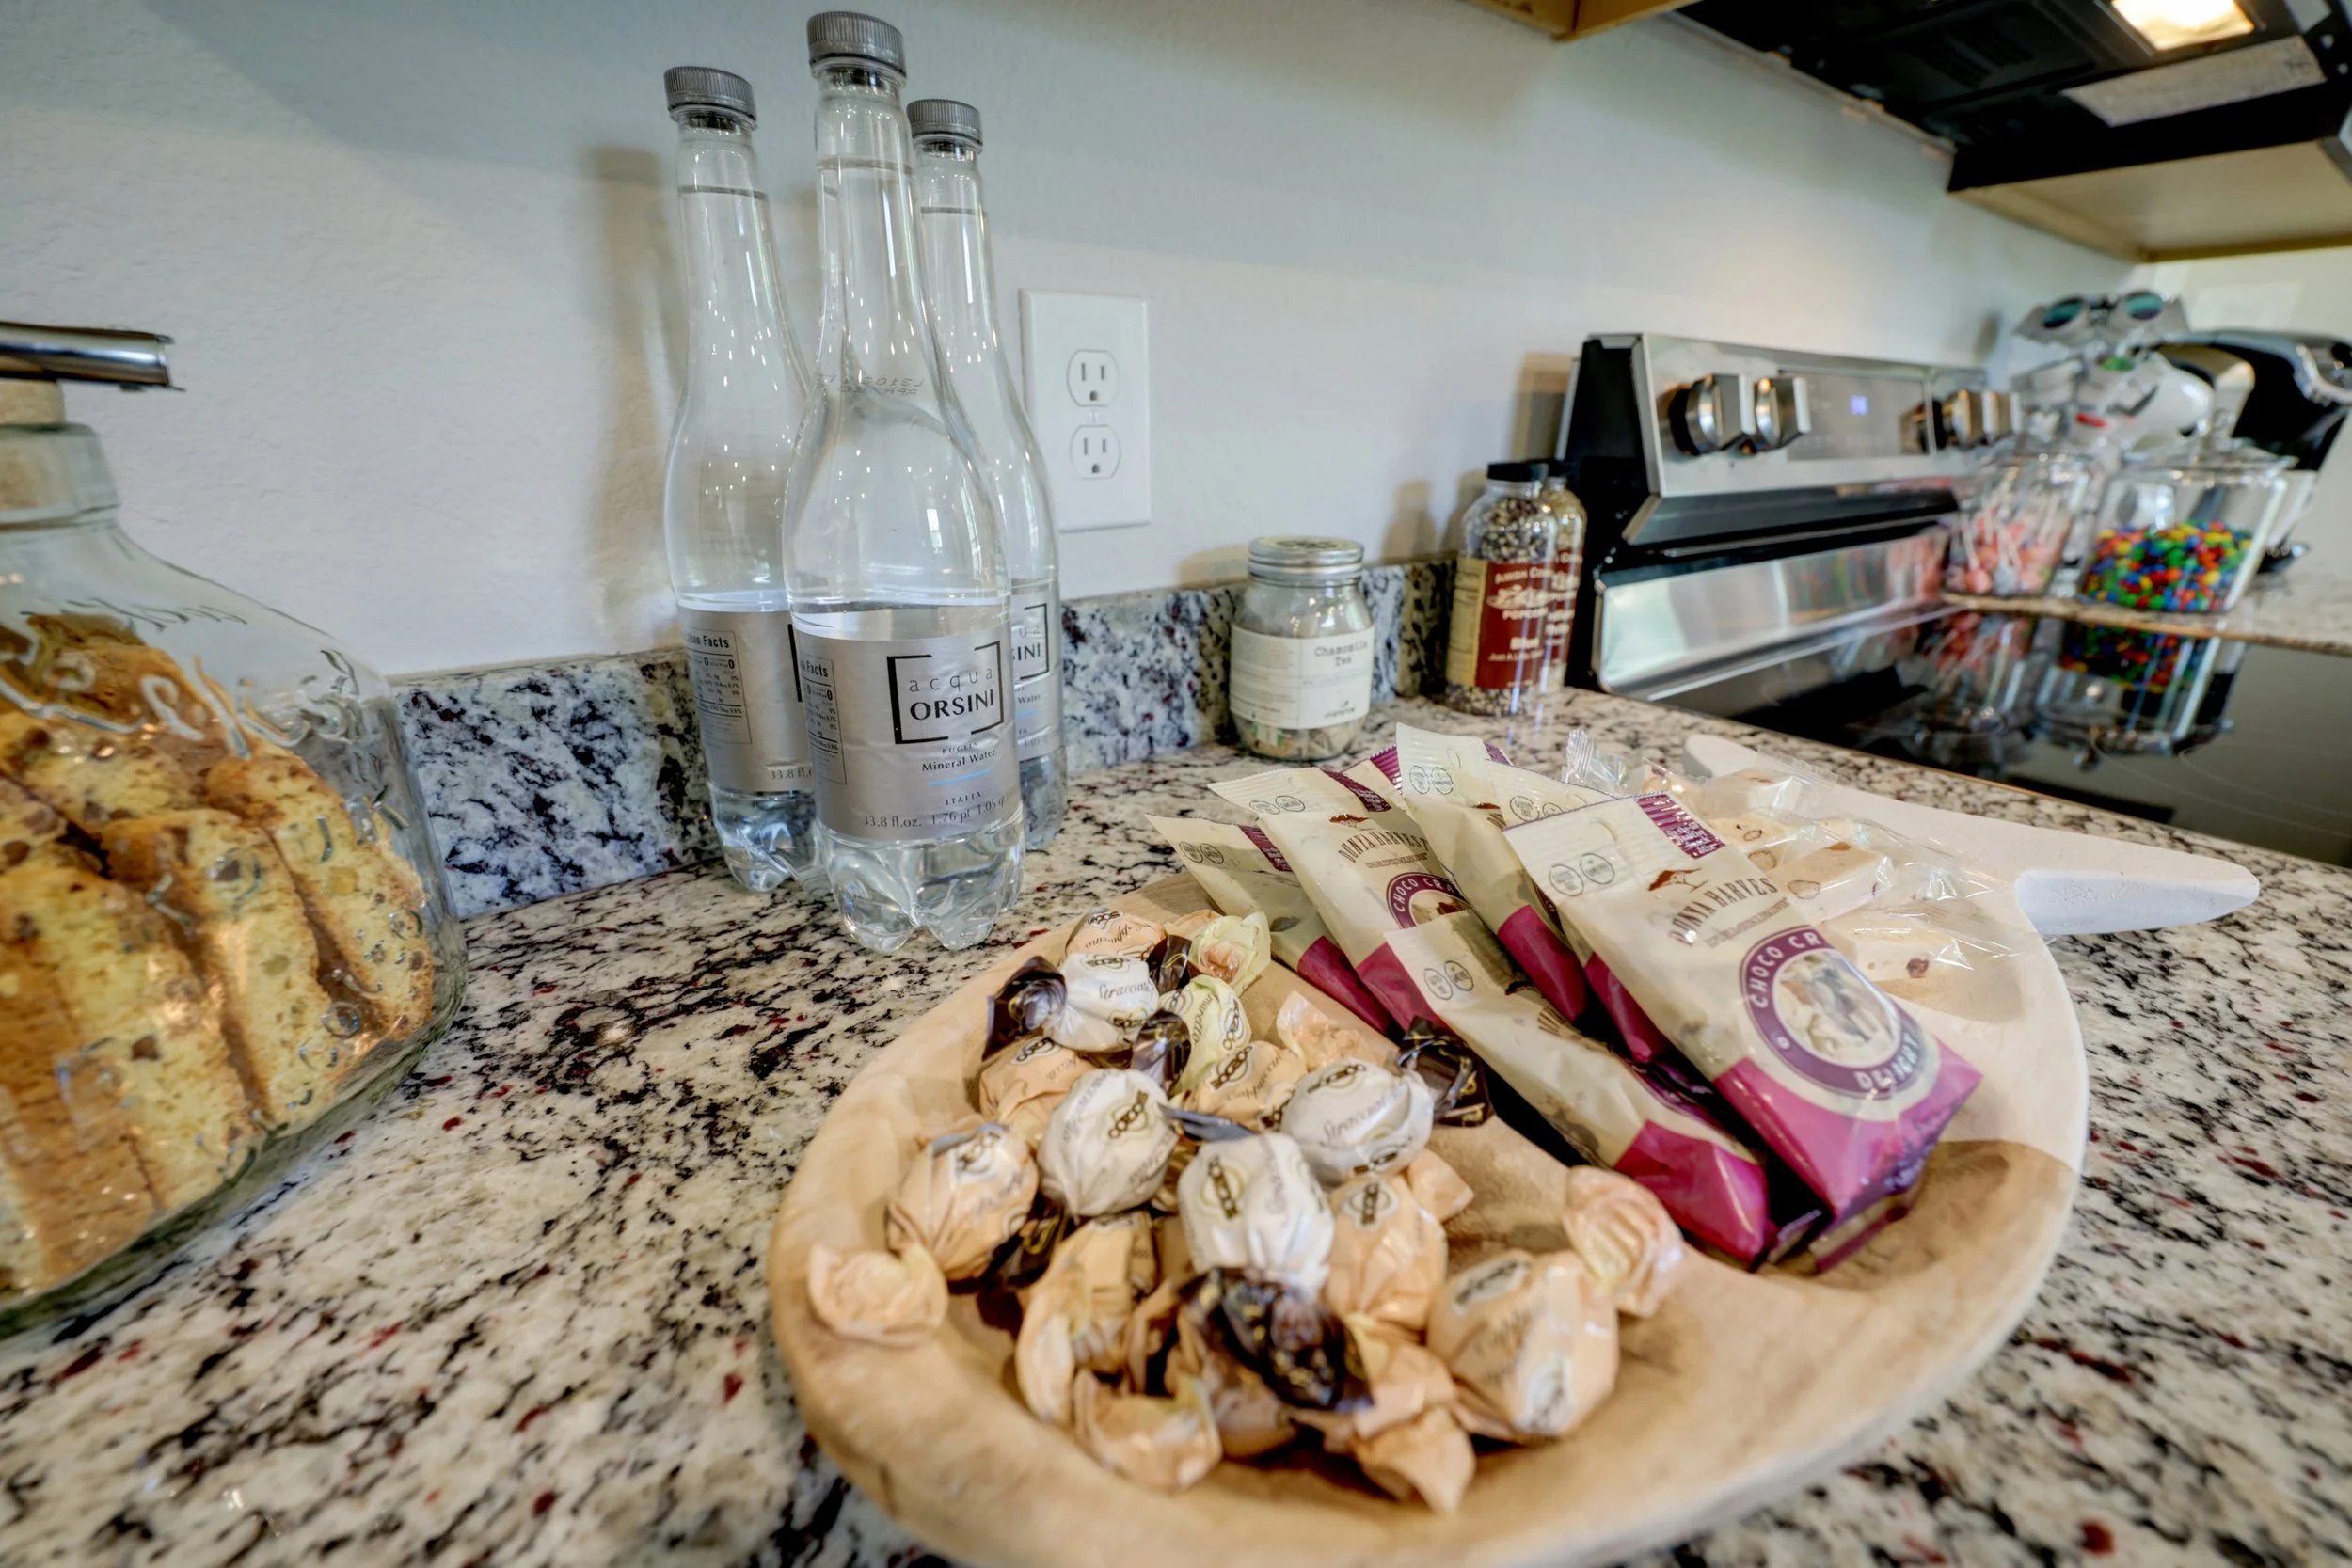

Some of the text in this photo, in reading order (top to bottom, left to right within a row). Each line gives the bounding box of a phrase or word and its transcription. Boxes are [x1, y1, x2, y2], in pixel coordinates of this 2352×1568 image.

[703, 636, 729, 648] Facts
[1314, 641, 1369, 657] Chamomile
[728, 658, 735, 669] 0
[806, 661, 829, 677] Facts
[1335, 656, 1352, 667] Tea
[909, 668, 993, 692] acqua
[827, 690, 833, 700] 0
[910, 689, 993, 721] ORSINI
[922, 749, 997, 772] Mineral Water
[771, 768, 795, 780] 33.8
[946, 791, 982, 806] ITALIA
[863, 816, 888, 828] 33.8
[892, 816, 922, 828] fl.oz.
[930, 809, 957, 825] 1.76
[960, 809, 971, 824] pt
[977, 800, 997, 816] 1.05
[1338, 833, 1376, 863] DUNYA
[1370, 832, 1429, 852] HARVEST
[1393, 878, 1419, 912] CHOCO
[1668, 900, 1717, 946] DUNYA
[1748, 946, 1784, 1008] CHOCO
